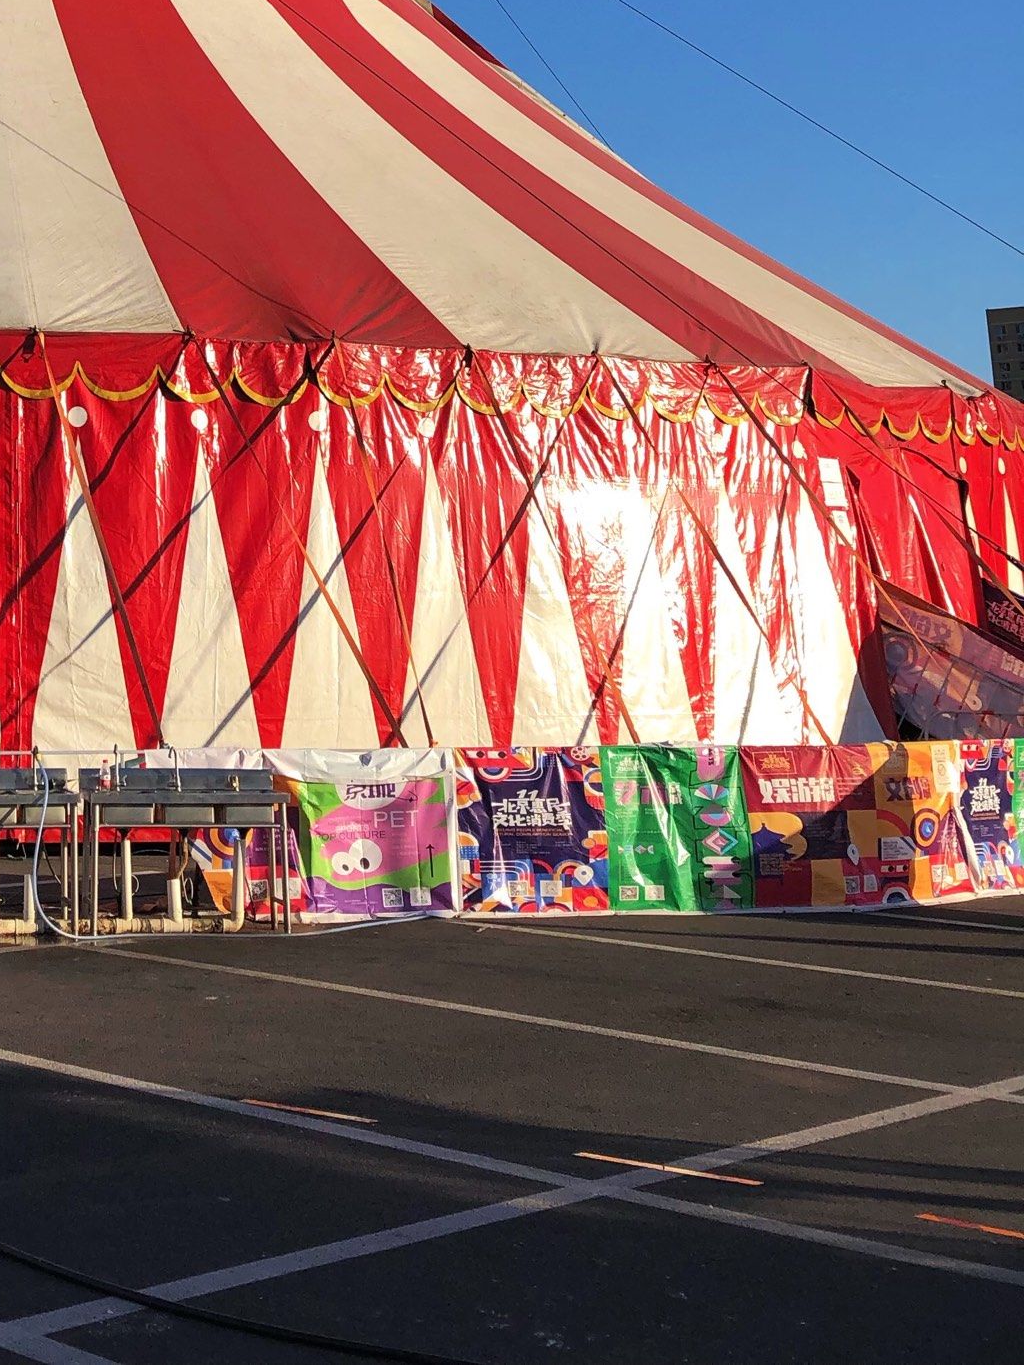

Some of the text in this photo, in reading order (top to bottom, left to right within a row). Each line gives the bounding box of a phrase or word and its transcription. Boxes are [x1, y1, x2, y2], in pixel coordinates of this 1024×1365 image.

[491, 797, 571, 815] 北京惠民
[373, 809, 419, 828] PET
